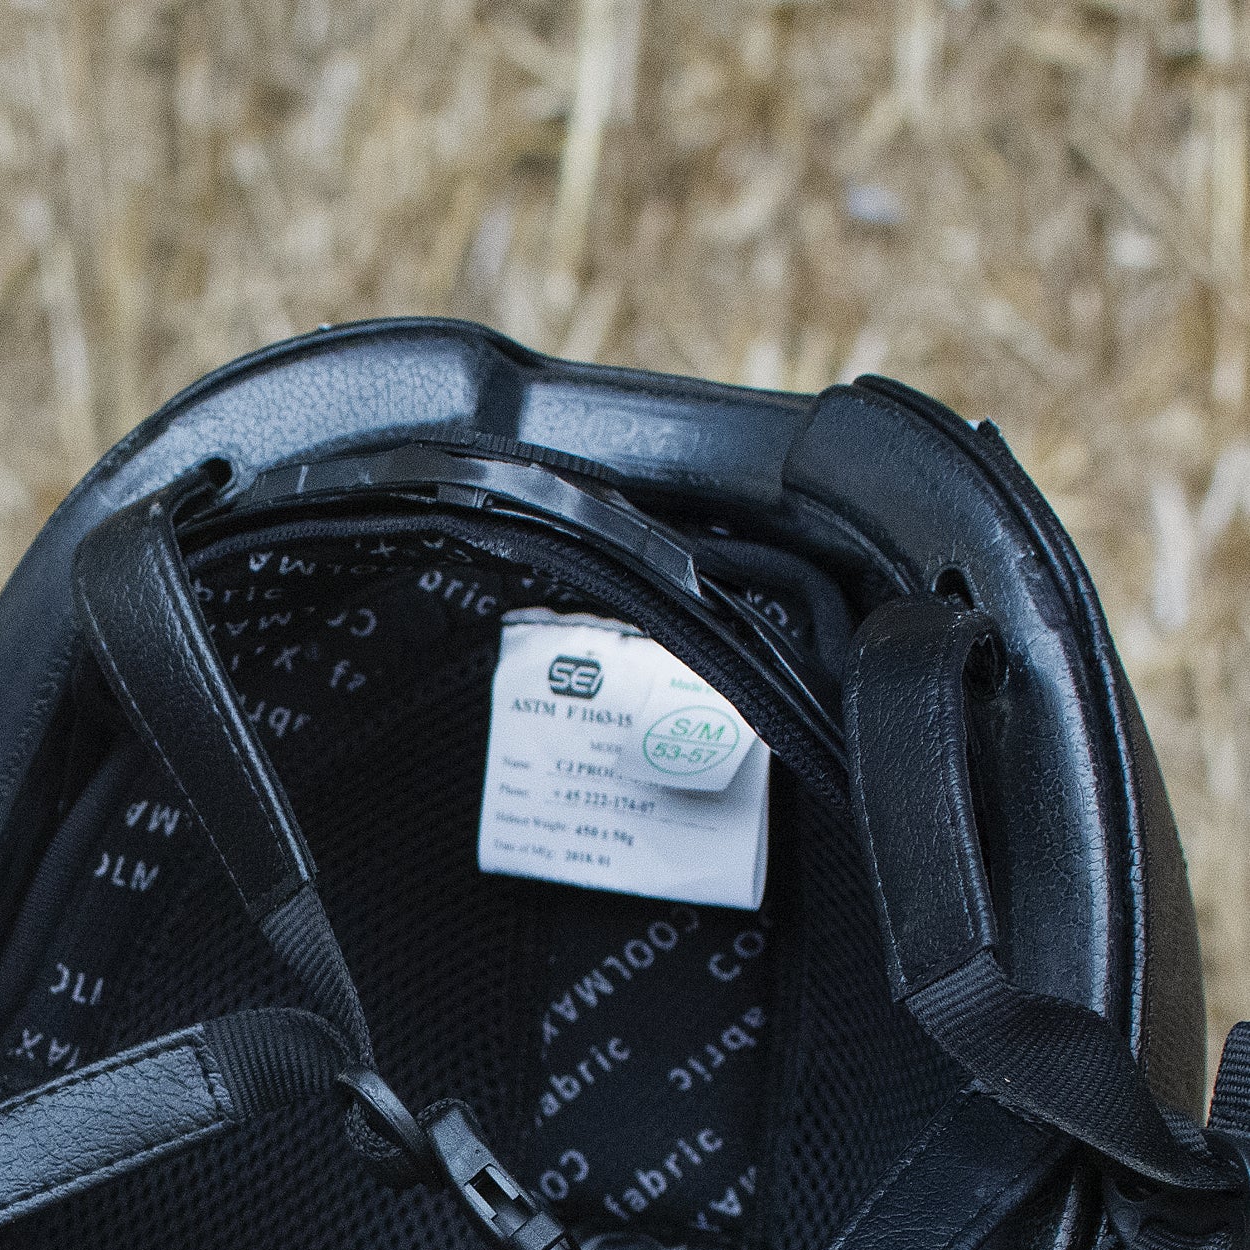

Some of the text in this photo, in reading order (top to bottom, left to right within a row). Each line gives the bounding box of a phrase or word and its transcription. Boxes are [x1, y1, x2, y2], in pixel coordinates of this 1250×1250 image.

[510, 697, 557, 718] ASTM
[670, 716, 726, 744] S/M
[651, 741, 718, 765] 53-57
